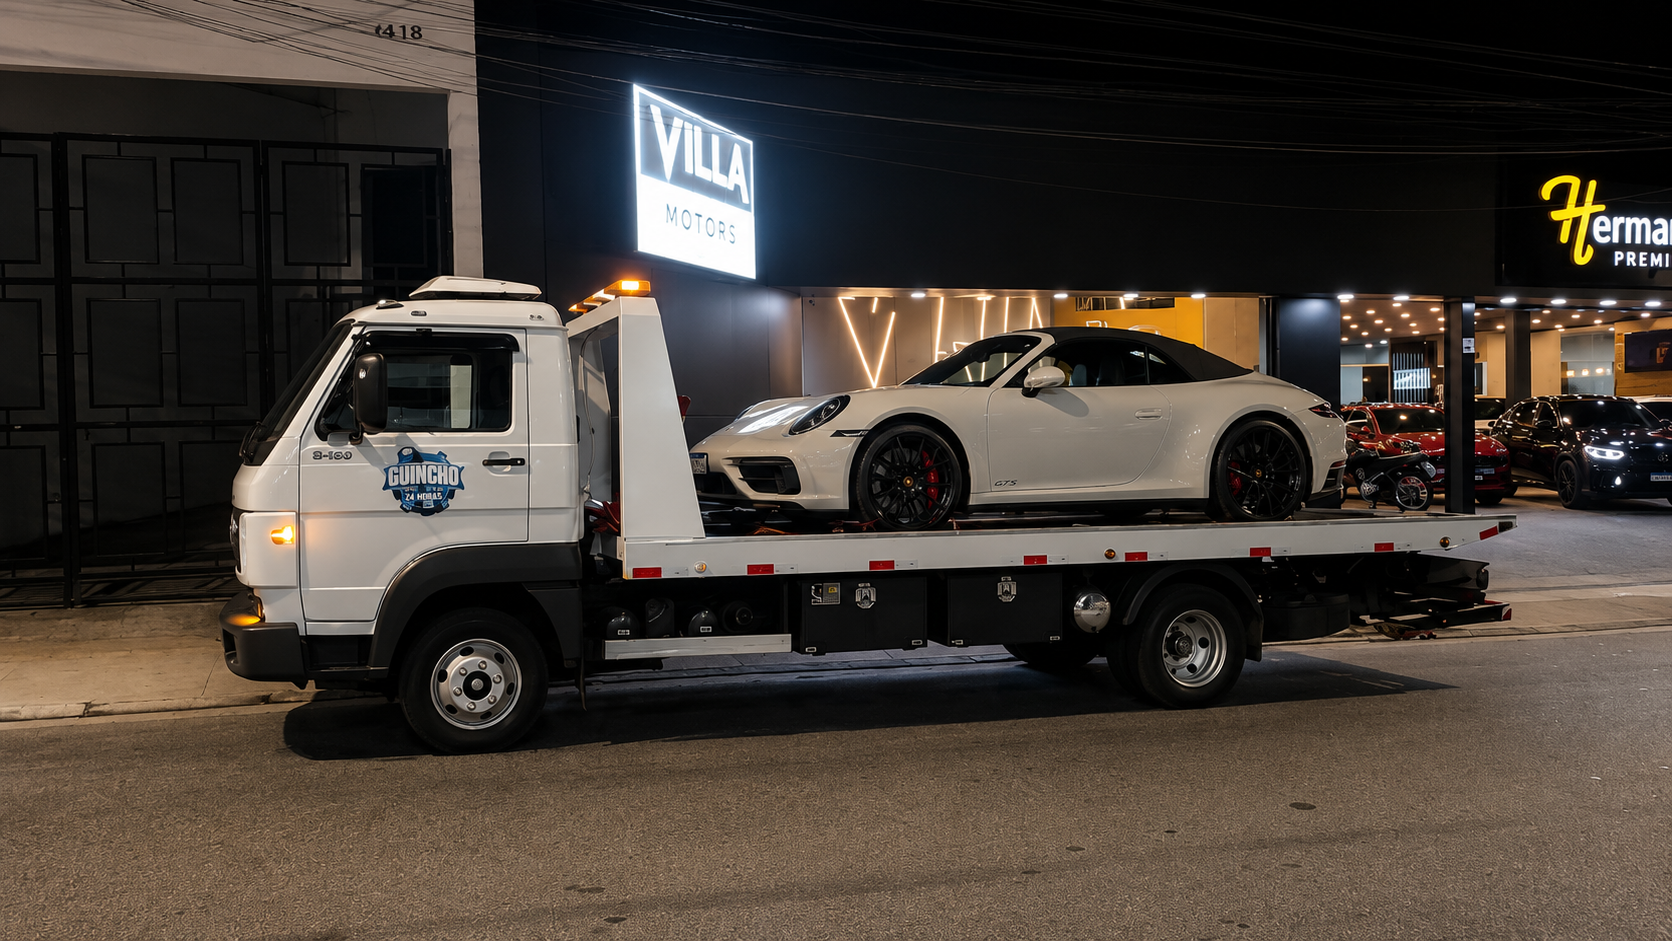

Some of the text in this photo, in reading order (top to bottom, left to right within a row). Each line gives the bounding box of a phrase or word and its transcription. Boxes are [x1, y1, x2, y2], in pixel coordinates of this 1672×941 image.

[650, 103, 750, 205] VILLA
[665, 203, 736, 245] MOTORS
[1540, 174, 1672, 266] Herma
[388, 464, 459, 487] GUINCHO
[994, 479, 1018, 487] GTS
